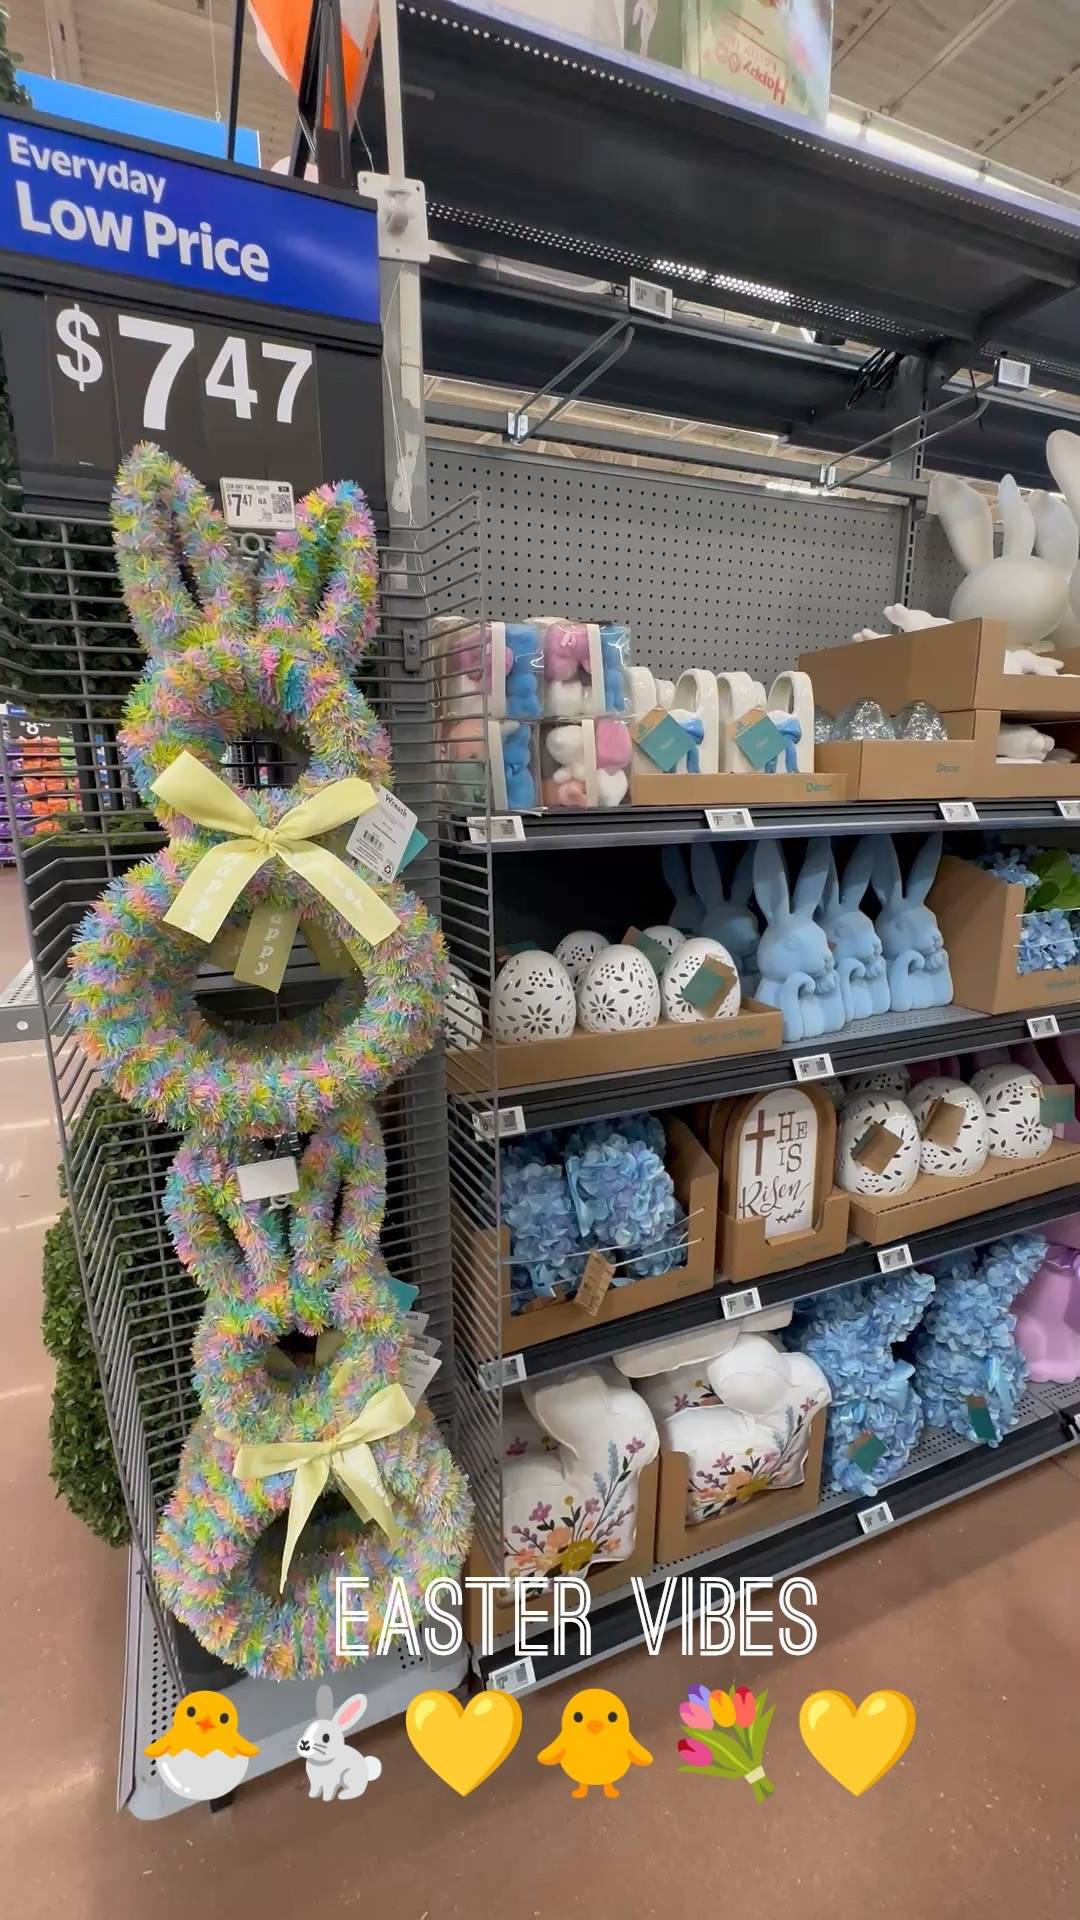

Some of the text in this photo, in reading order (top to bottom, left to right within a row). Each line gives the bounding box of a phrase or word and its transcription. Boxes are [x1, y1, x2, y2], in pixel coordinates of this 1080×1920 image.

[742, 60, 786, 105] Happy
[8, 132, 166, 204] Everyday
[143, 210, 269, 282] Price
[384, 793, 408, 819] Wreath
[253, 913, 284, 976] appy
[776, 1110, 808, 1144] HE
[778, 1143, 803, 1173] IS
[738, 1175, 811, 1220] Risen
